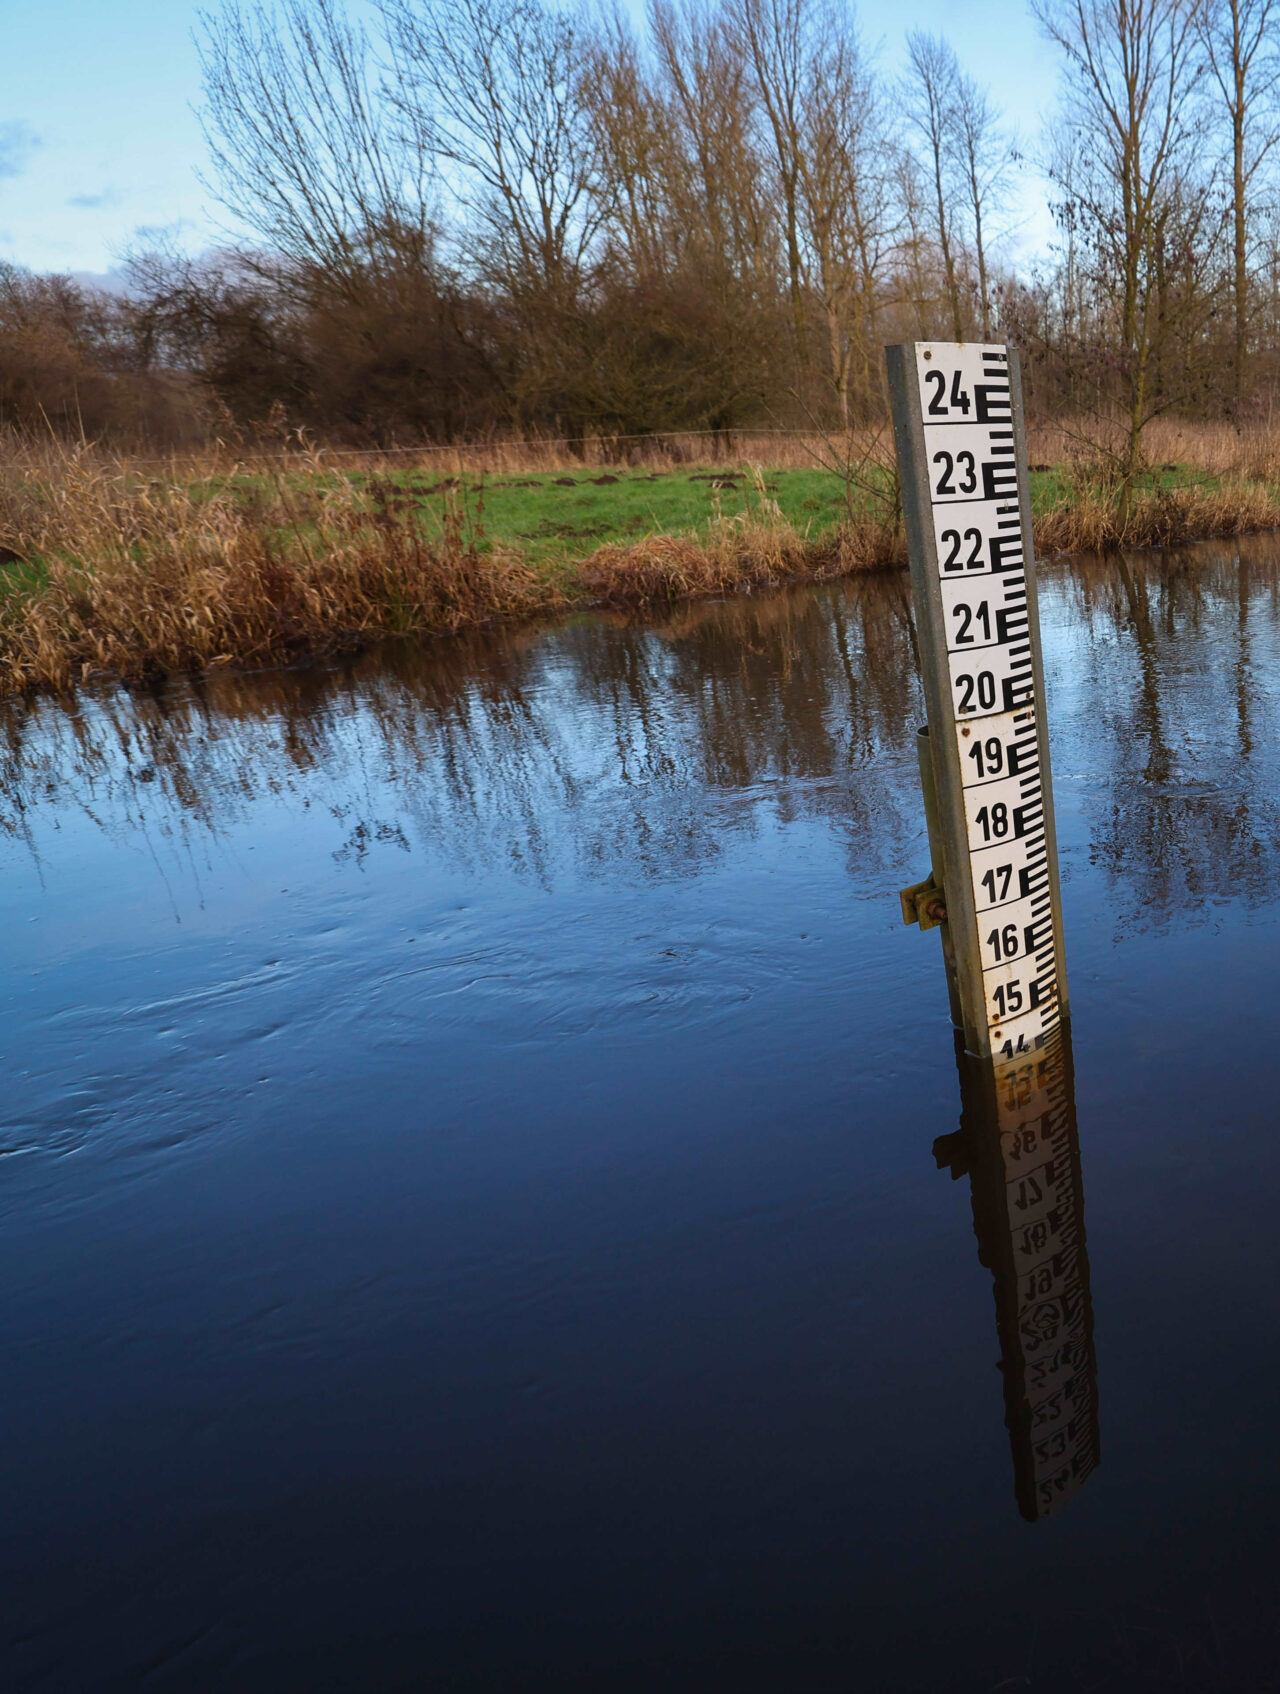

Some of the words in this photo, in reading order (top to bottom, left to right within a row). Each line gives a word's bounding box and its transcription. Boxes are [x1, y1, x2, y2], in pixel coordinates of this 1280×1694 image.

[925, 369, 970, 416] 24
[933, 450, 977, 495] 23
[941, 527, 985, 572] 22
[952, 600, 991, 644] 21
[955, 670, 995, 714] 20
[968, 737, 1003, 778] 19
[975, 802, 1009, 841] 18
[981, 864, 1013, 904] 17
[986, 924, 1019, 962] 16
[993, 979, 1023, 1016] 15
[1000, 1034, 1031, 1060] 14
